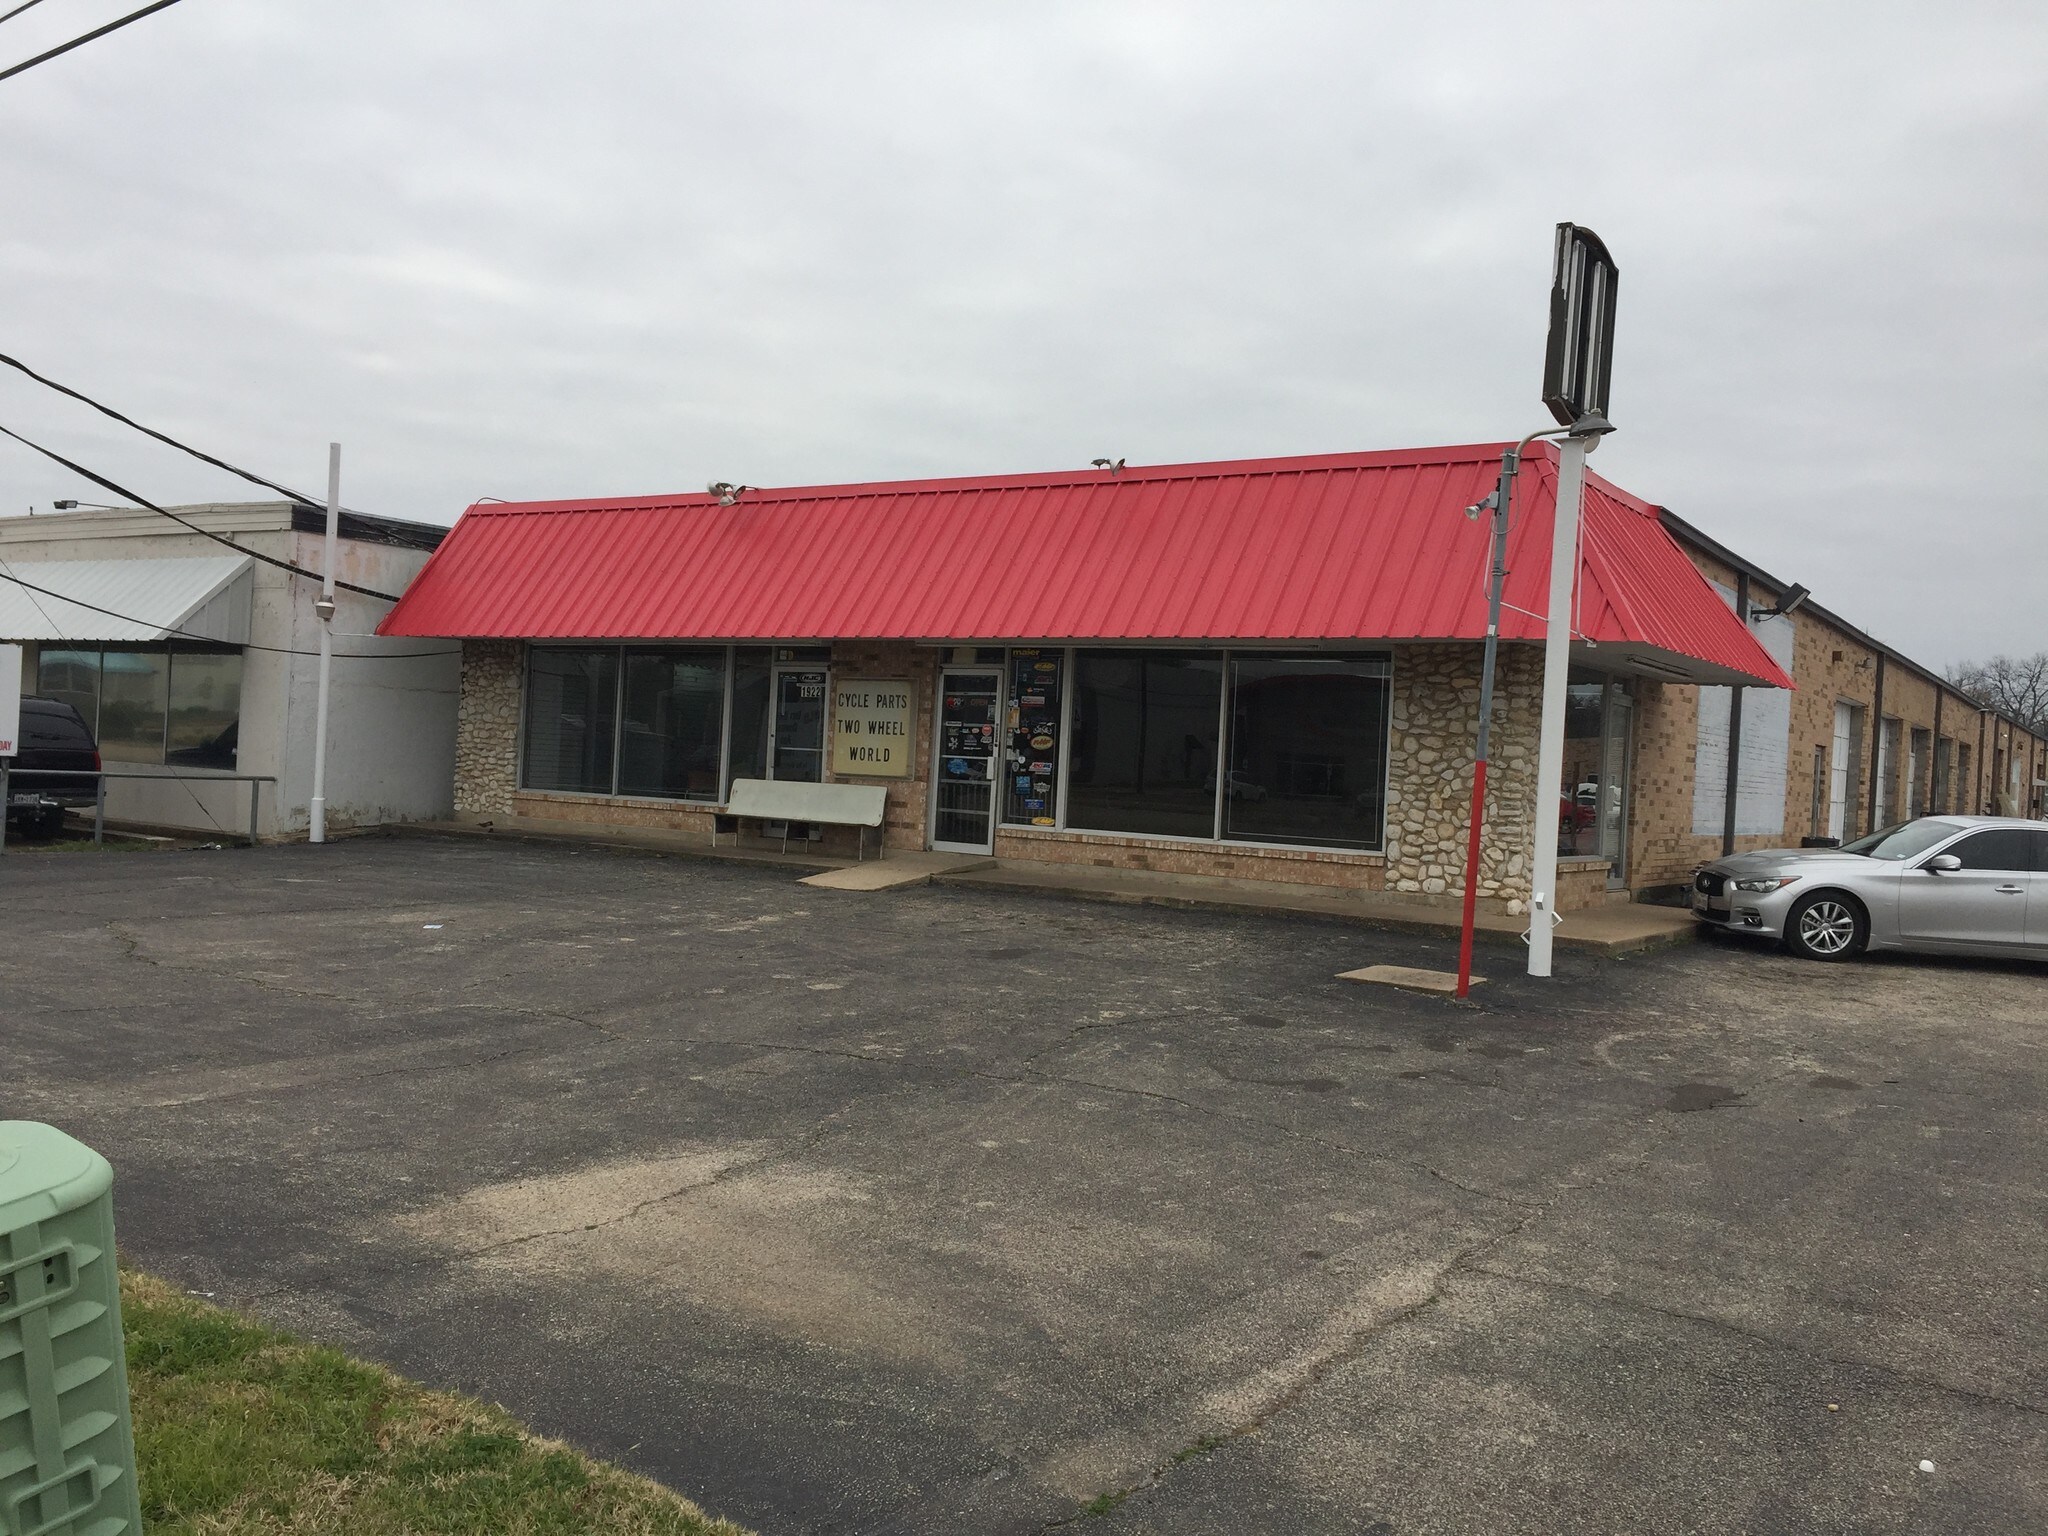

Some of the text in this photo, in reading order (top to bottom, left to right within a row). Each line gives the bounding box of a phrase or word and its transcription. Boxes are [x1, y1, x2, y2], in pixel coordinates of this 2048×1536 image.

[801, 686, 821, 697] 1922
[838, 692, 907, 709] CYCLE PARTS
[837, 719, 905, 736] TWO WHEEL
[849, 746, 890, 763] WORLD
